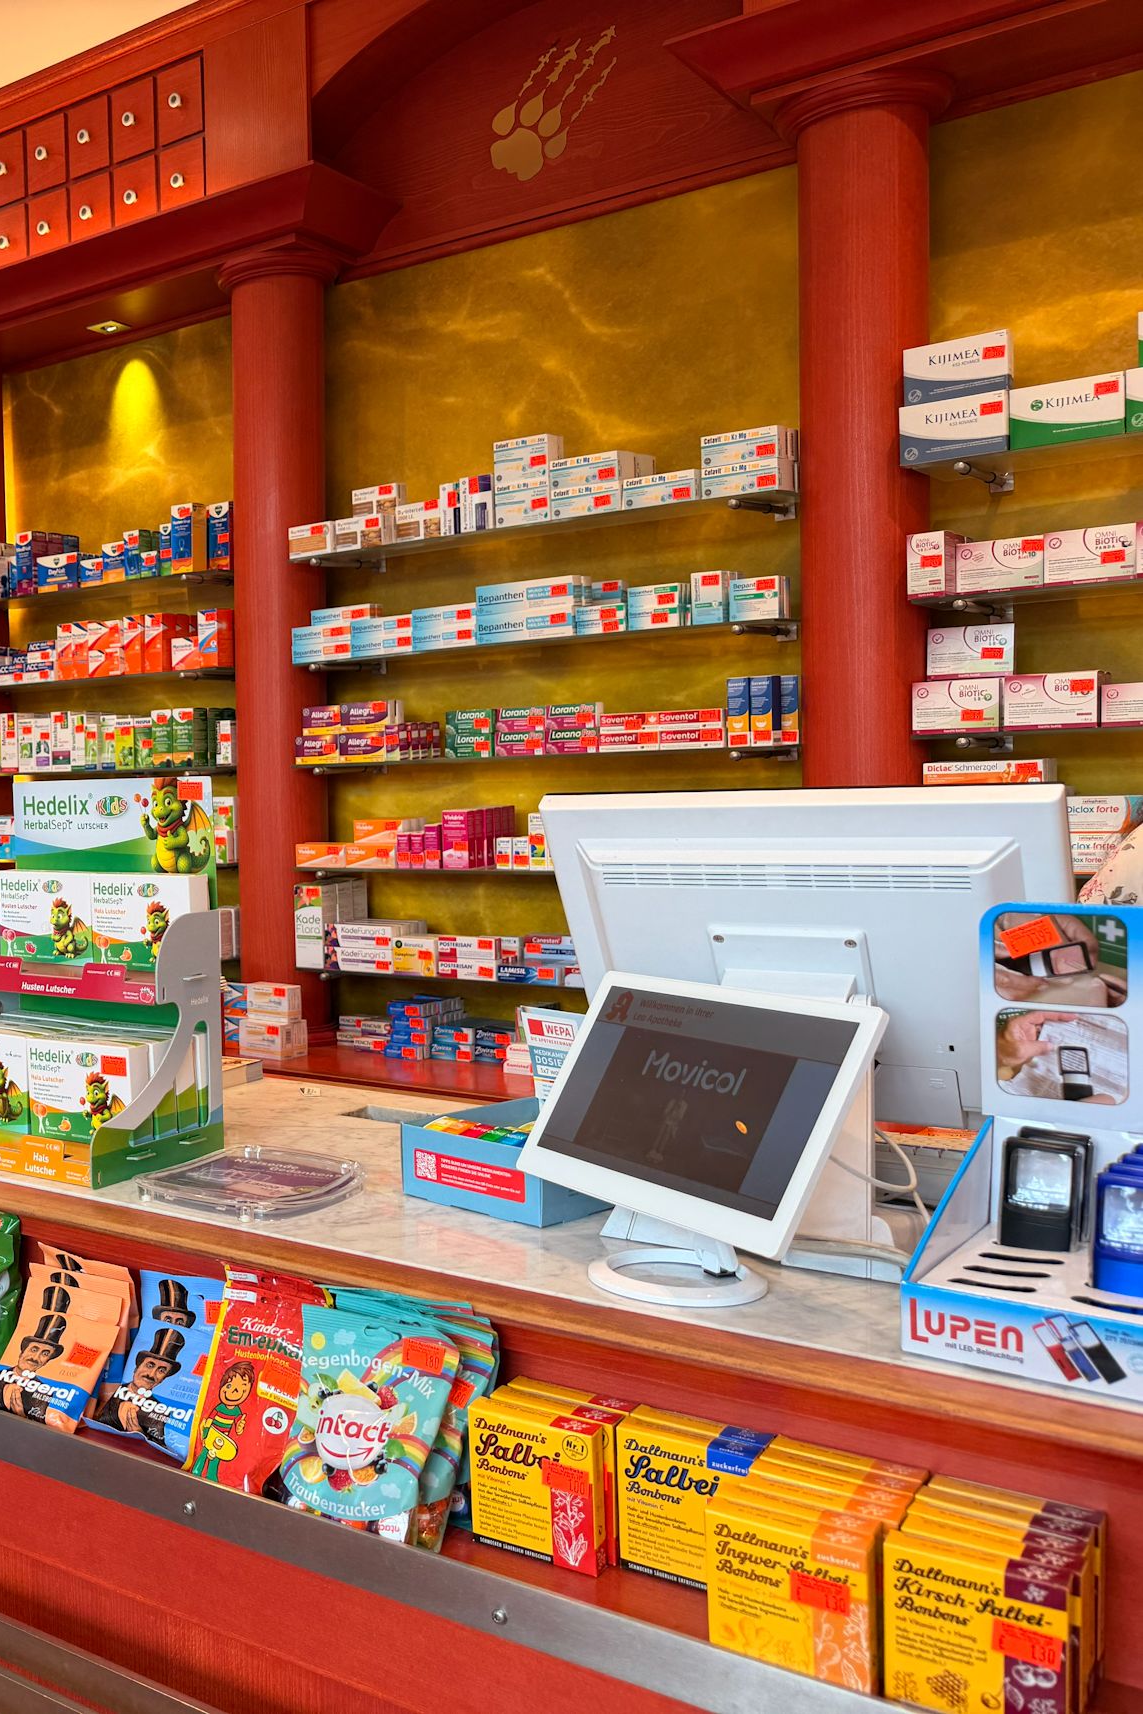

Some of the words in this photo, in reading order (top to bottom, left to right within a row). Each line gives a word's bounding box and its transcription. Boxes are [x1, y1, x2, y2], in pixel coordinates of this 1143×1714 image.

[929, 349, 979, 365] KIJIMEA
[1046, 394, 1100, 408] KIJIMEA
[925, 408, 977, 424] KIJIMEA
[733, 582, 757, 590] Bepant
[479, 591, 524, 604] Bepanthen
[313, 612, 340, 621] Bepanthen
[413, 612, 441, 622] Bepanthen
[352, 623, 382, 632] Bepanthen
[479, 621, 524, 632] Bepanthen
[294, 631, 321, 639] Bepanthen
[413, 634, 440, 642] Bepanthen
[352, 641, 381, 650] Bepanthen
[294, 649, 321, 657] Bepanthen
[458, 711, 485, 720] Lorano
[660, 713, 698, 722] Soventol
[457, 735, 484, 744] Lorano
[601, 734, 636, 743] Soventol
[661, 732, 699, 741] Soventol
[304, 740, 326, 748] Allegra
[955, 763, 998, 773] Schmerzgel
[23, 796, 90, 815] Hedelix
[96, 796, 128, 816] Kids
[24, 819, 72, 832] HerbalSept
[1, 879, 38, 892] Hedelix
[93, 882, 133, 896] Hedelix
[296, 914, 320, 924] Kade
[297, 924, 320, 934] Flora
[340, 926, 379, 935] KadeFungin
[532, 936, 560, 944] Canesten
[340, 950, 379, 959] KadeFungin
[500, 967, 526, 975] LAMISIL
[21, 982, 45, 992] Husten
[46, 984, 76, 994] Lutscher
[648, 1015, 682, 1028] Apotheke
[545, 1024, 571, 1037] WEPA
[30, 1048, 71, 1064] Hedelix
[535, 1055, 563, 1066] DOSIE
[42, 1075, 64, 1083] Lutscher
[642, 1050, 746, 1096] Movicol
[33, 1152, 49, 1163] Hals
[25, 1163, 56, 1176] Lutscher
[240, 1317, 293, 1336] Kinder
[910, 1297, 1023, 1353] LUPEN
[228, 1326, 303, 1360] Em-euka
[945, 1342, 957, 1351] mit
[959, 1343, 1024, 1364] LED-Beleuchtung
[32, 1392, 69, 1409] HALSBONBONS
[114, 1386, 194, 1422] Krügerol
[148, 1412, 187, 1430] HALSBONBONS
[316, 1410, 390, 1444] intact
[474, 1418, 547, 1444] Dallmann's
[624, 1438, 705, 1467] Dallmann's
[476, 1458, 528, 1480] Bonbons
[712, 1461, 748, 1474] zuckerfrei
[625, 1454, 720, 1497] Salbei
[289, 1472, 386, 1518] Traubenzucker
[626, 1481, 682, 1505] Bonbons
[714, 1523, 809, 1559] Dallmann's
[816, 1554, 860, 1569] zuckerfrei
[716, 1558, 782, 1588] Bonbons
[893, 1558, 1002, 1597] Dallmann's
[894, 1576, 1053, 1627] Kirsch-Salbei-
[894, 1595, 970, 1627] Bonbons
